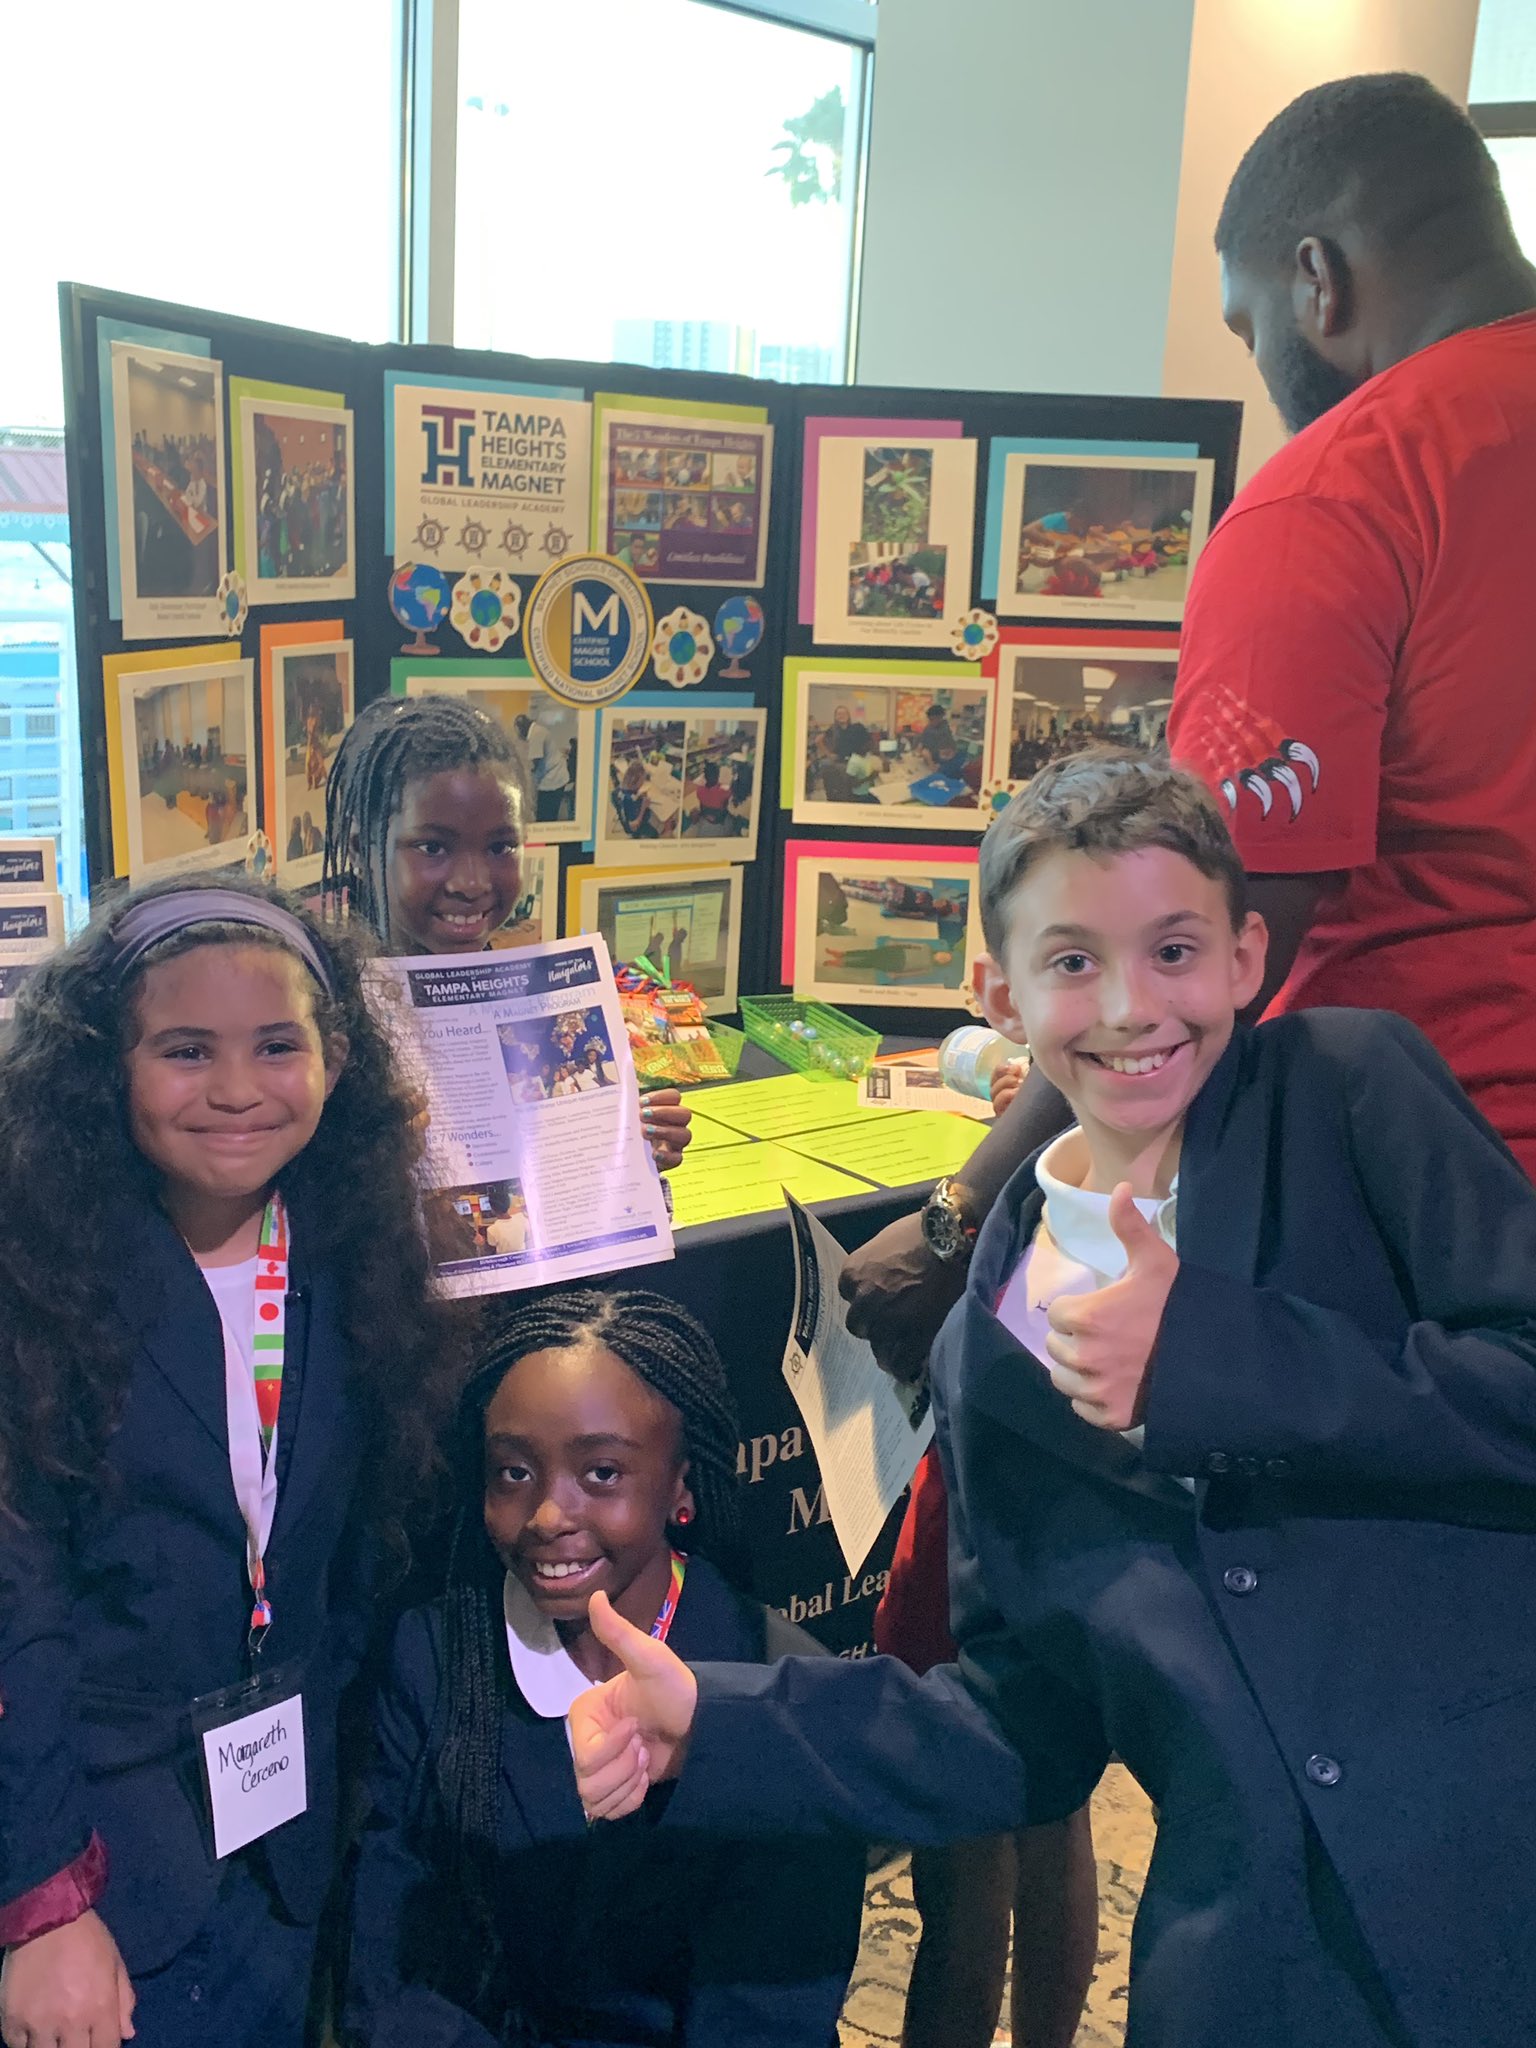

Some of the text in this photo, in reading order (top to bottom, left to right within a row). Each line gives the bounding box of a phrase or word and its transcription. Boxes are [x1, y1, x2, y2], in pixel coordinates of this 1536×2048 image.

[482, 410, 566, 439] TAMPA
[481, 436, 567, 460] HEIGHTS
[481, 456, 566, 474] ELEMENTARY
[481, 472, 566, 494] MAGNET
[421, 495, 565, 514] GLOBAL LEADERSHIP ACADEMY
[573, 591, 620, 636] M
[573, 637, 609, 646] CERTIFIED
[573, 647, 611, 656] MAGNET
[573, 657, 611, 667] SCHOOL
[553, 675, 595, 699] NATIONAL
[415, 961, 532, 981] GLOBAL LEADERSHIP ACADEMY
[424, 974, 530, 996] TAMPA HEIGHTS
[432, 986, 524, 1003] ELEMENTARY MAGNET
[421, 1030, 443, 1040] You
